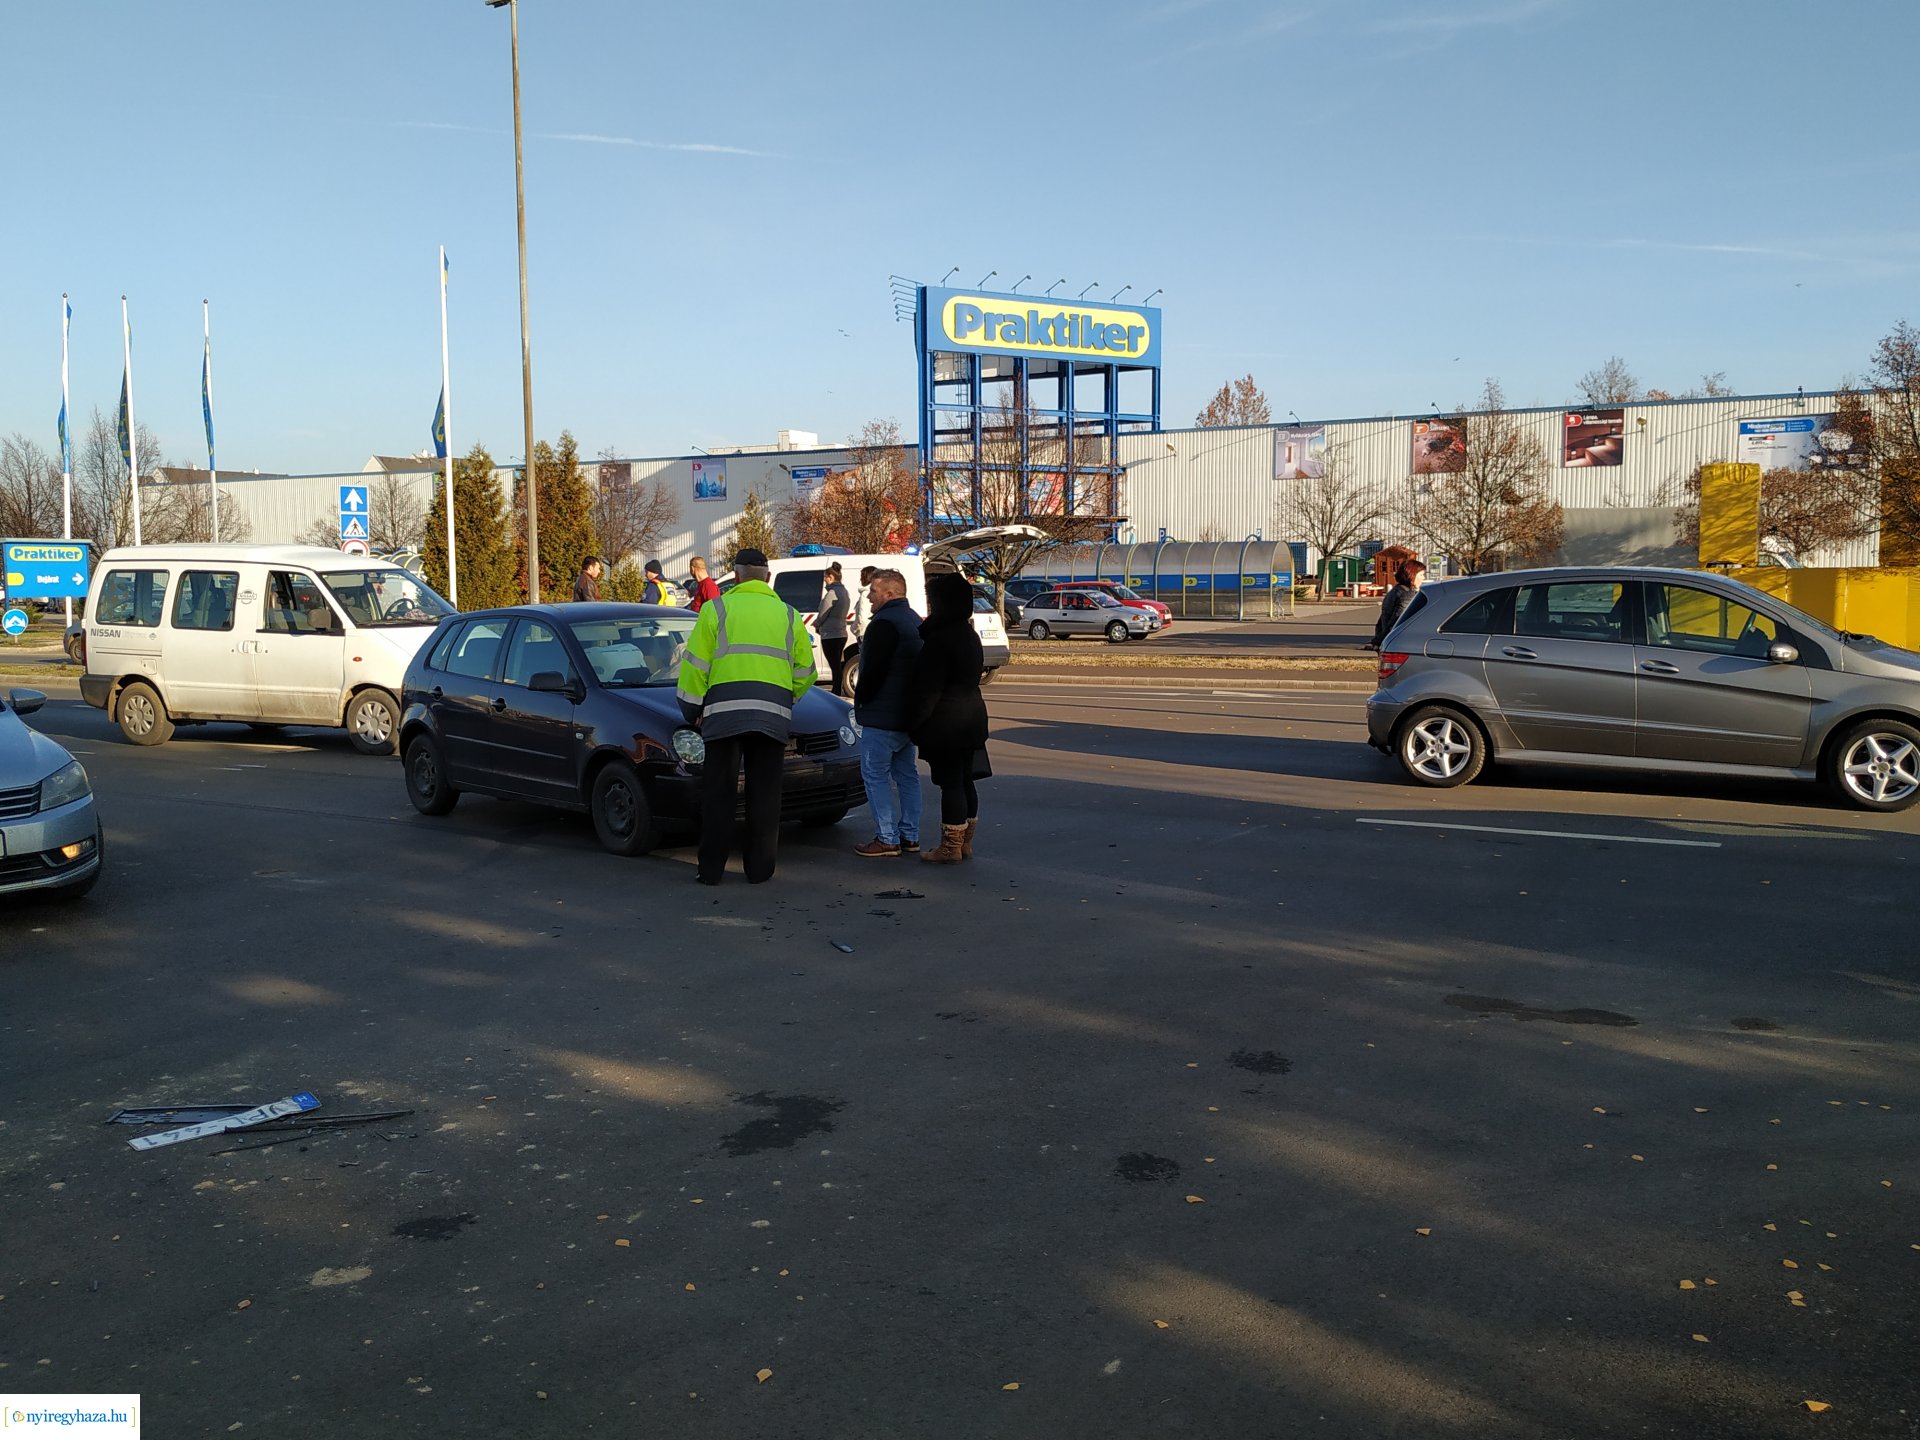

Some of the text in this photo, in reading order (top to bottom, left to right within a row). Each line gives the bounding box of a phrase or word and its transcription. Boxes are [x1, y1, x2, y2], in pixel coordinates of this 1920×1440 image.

[954, 302, 1145, 353] Praktiker
[13, 548, 80, 560] Praktiker
[90, 627, 121, 638] NISSAN
